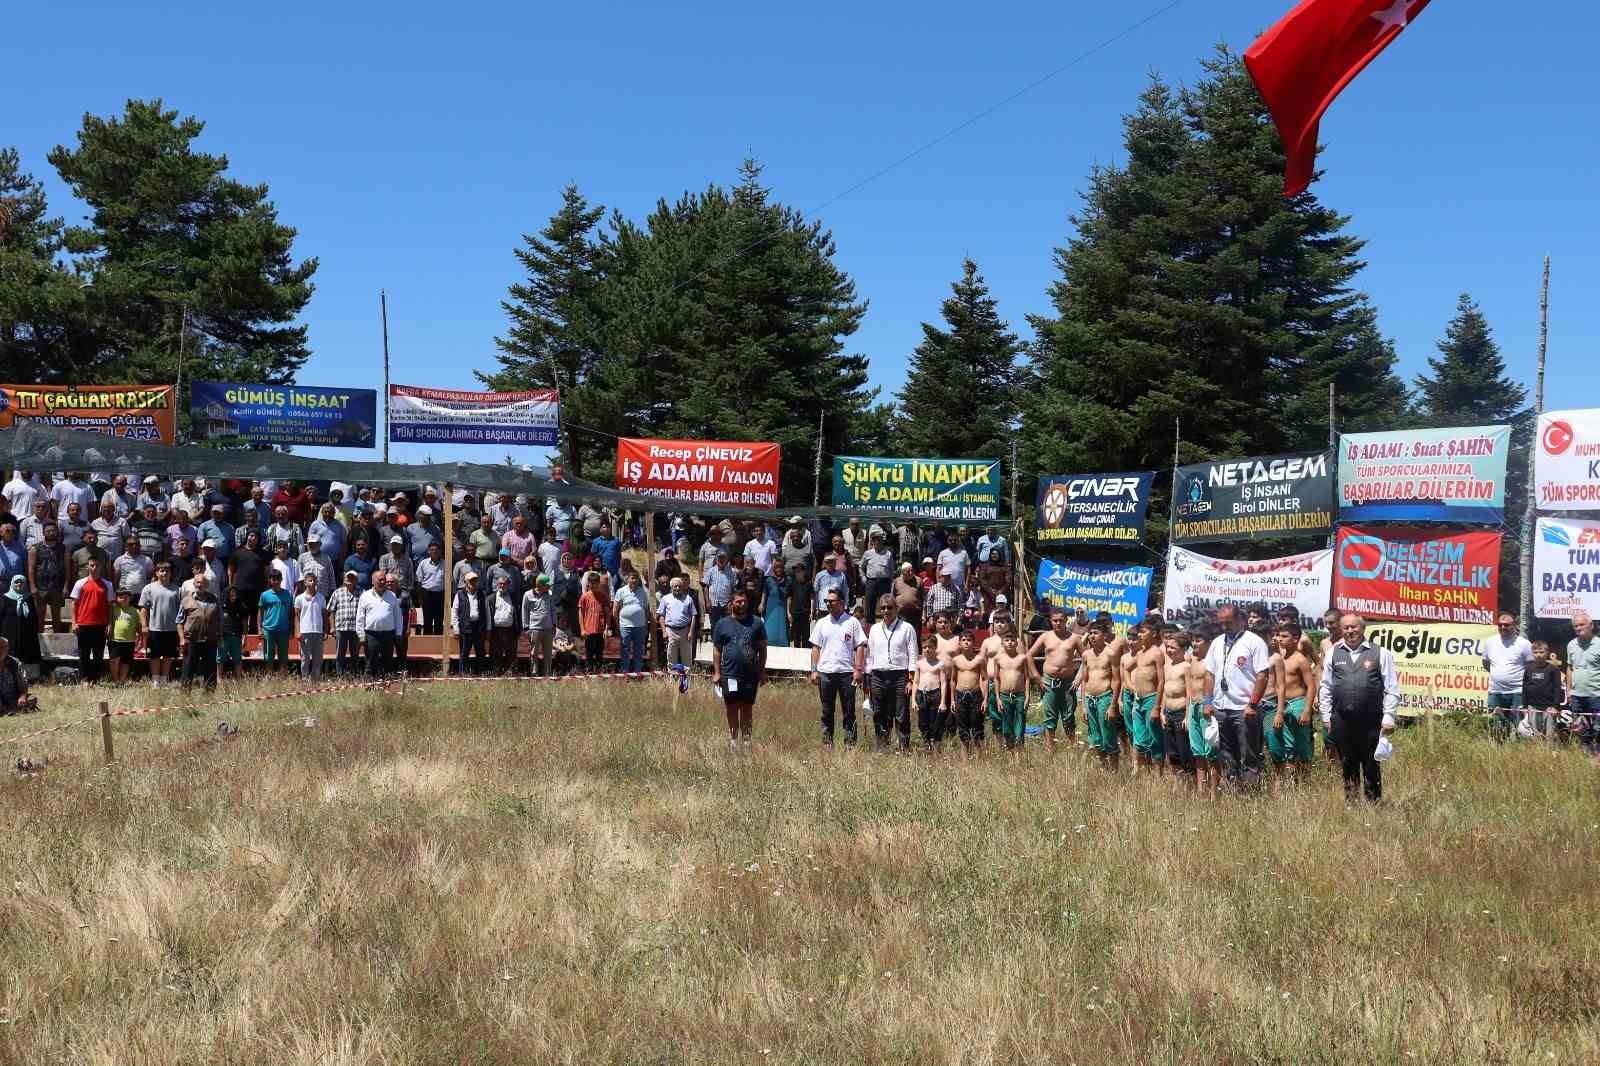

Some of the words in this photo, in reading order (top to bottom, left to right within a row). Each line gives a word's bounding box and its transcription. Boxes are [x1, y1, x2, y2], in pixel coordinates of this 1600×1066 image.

[225, 387, 285, 407] GÜMÜŞ
[290, 390, 350, 408] İNŞAAT
[396, 427, 413, 438] TÜM
[416, 428, 483, 439] SPORCULARIMIZA
[486, 431, 526, 441] BAŞARILAR
[650, 446, 692, 461] Recep
[696, 446, 752, 462] ÇİNEVİZ
[1348, 442, 1358, 463] İŞ
[1361, 442, 1403, 459] ADAMI
[1412, 442, 1442, 457] Suat
[1447, 435, 1495, 460] ŞAHİN
[623, 458, 642, 483] İŞ
[648, 464, 713, 482] ADAMI
[843, 462, 904, 487] Şükrü
[1208, 455, 1327, 487] NETAGEM
[1357, 463, 1375, 477] TÜM
[1378, 464, 1472, 477] SPORCULARIMIZA
[854, 483, 871, 503] İŞ
[877, 487, 933, 502] ADAMI
[1242, 486, 1251, 500] İŞ
[1255, 484, 1291, 498] İNSANI
[1344, 479, 1414, 504] BAŞARILAR
[1418, 476, 1494, 500] DİLERİM
[1542, 482, 1563, 501] TÜM
[963, 504, 996, 520] DİLERİM
[1070, 500, 1137, 512] TERSANECİLİK
[1233, 502, 1256, 514] Birol
[1259, 498, 1300, 511] DİNLER
[1097, 515, 1115, 525] ÇINAR
[1175, 520, 1190, 537] TÜM
[1190, 519, 1237, 536] SPORCULARA
[1239, 515, 1286, 537] BAŞARILAR
[1289, 508, 1331, 529] DİLERİM
[1185, 596, 1210, 609] TÜM
[1399, 584, 1429, 601] İlhan
[1434, 588, 1478, 605] ŞAHİN
[1348, 599, 1397, 615] SPORCULARA
[1400, 603, 1450, 621] BAŞARILAR
[1395, 672, 1430, 686] Yılmaz
